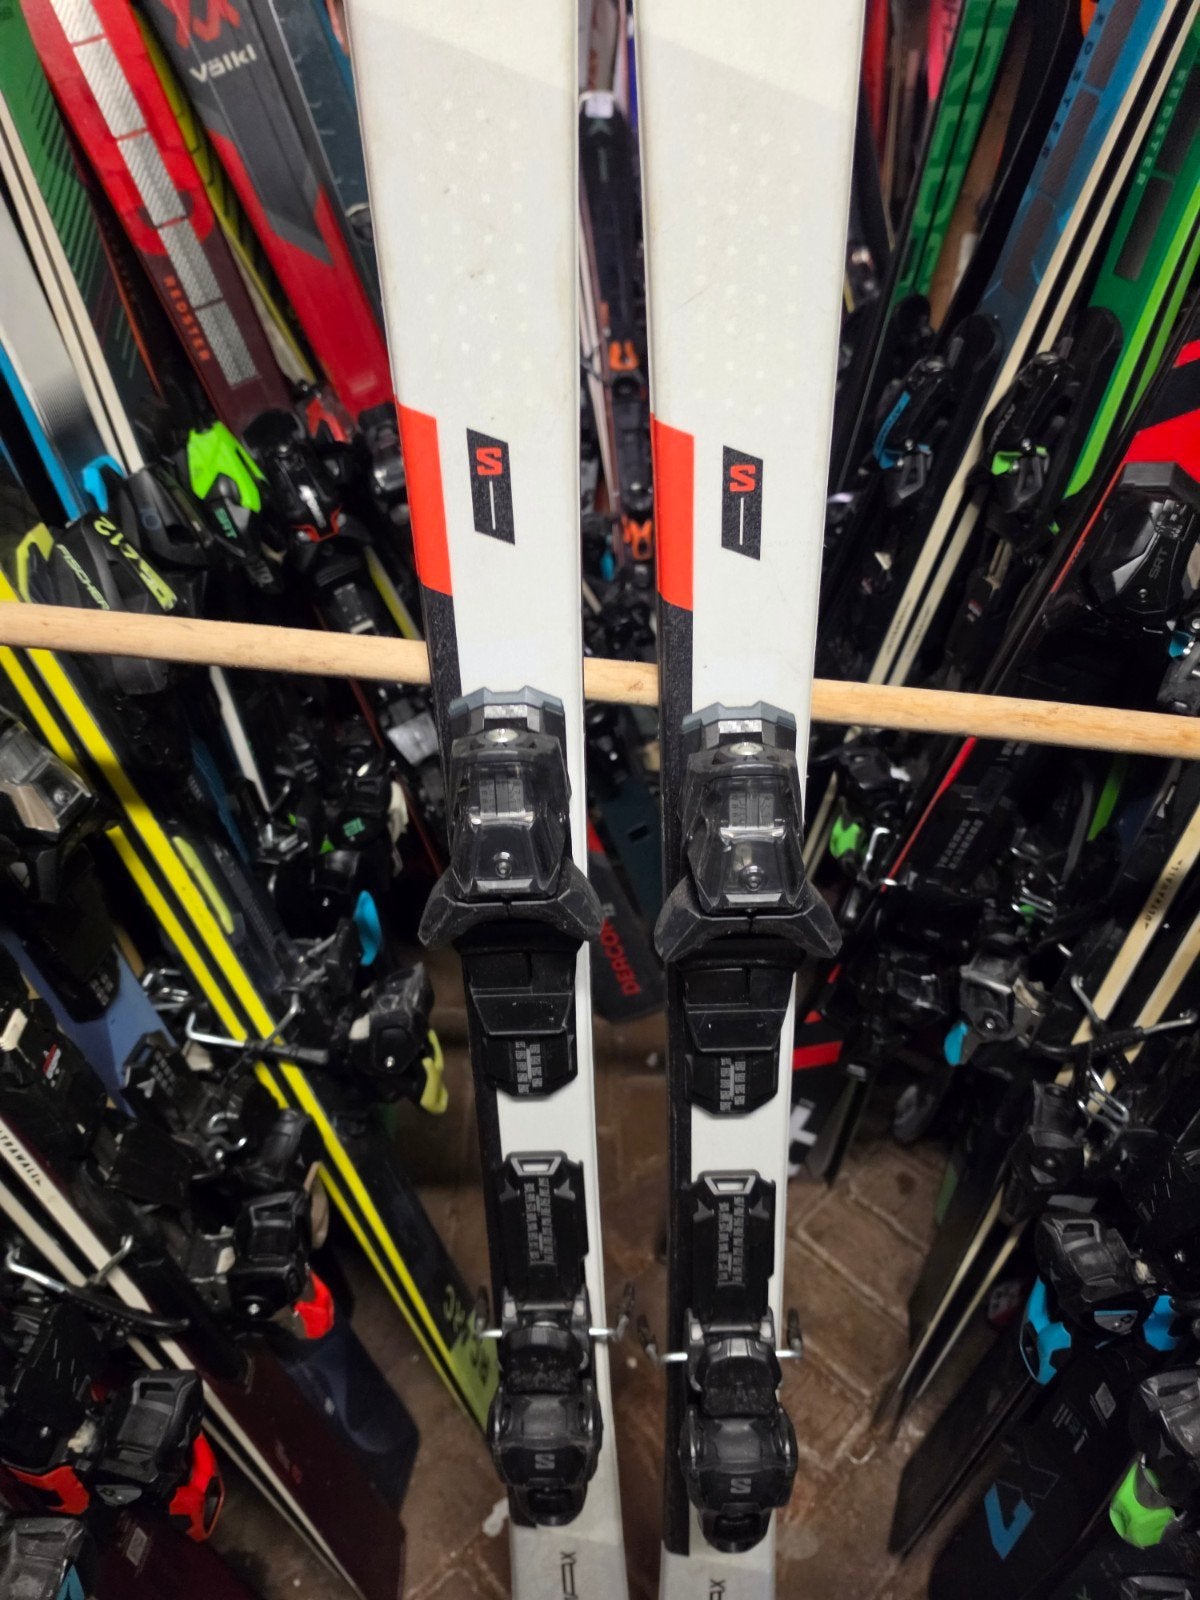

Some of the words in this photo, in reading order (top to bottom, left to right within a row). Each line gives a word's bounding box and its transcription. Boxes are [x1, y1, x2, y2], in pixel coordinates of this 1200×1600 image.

[163, 275, 210, 361] REDSTER
[476, 447, 502, 476] S
[729, 464, 756, 492] S
[1148, 546, 1168, 580] SRT
[1144, 865, 1180, 922] ULTRAWALL
[0, 1129, 39, 1180] TRAWALL
